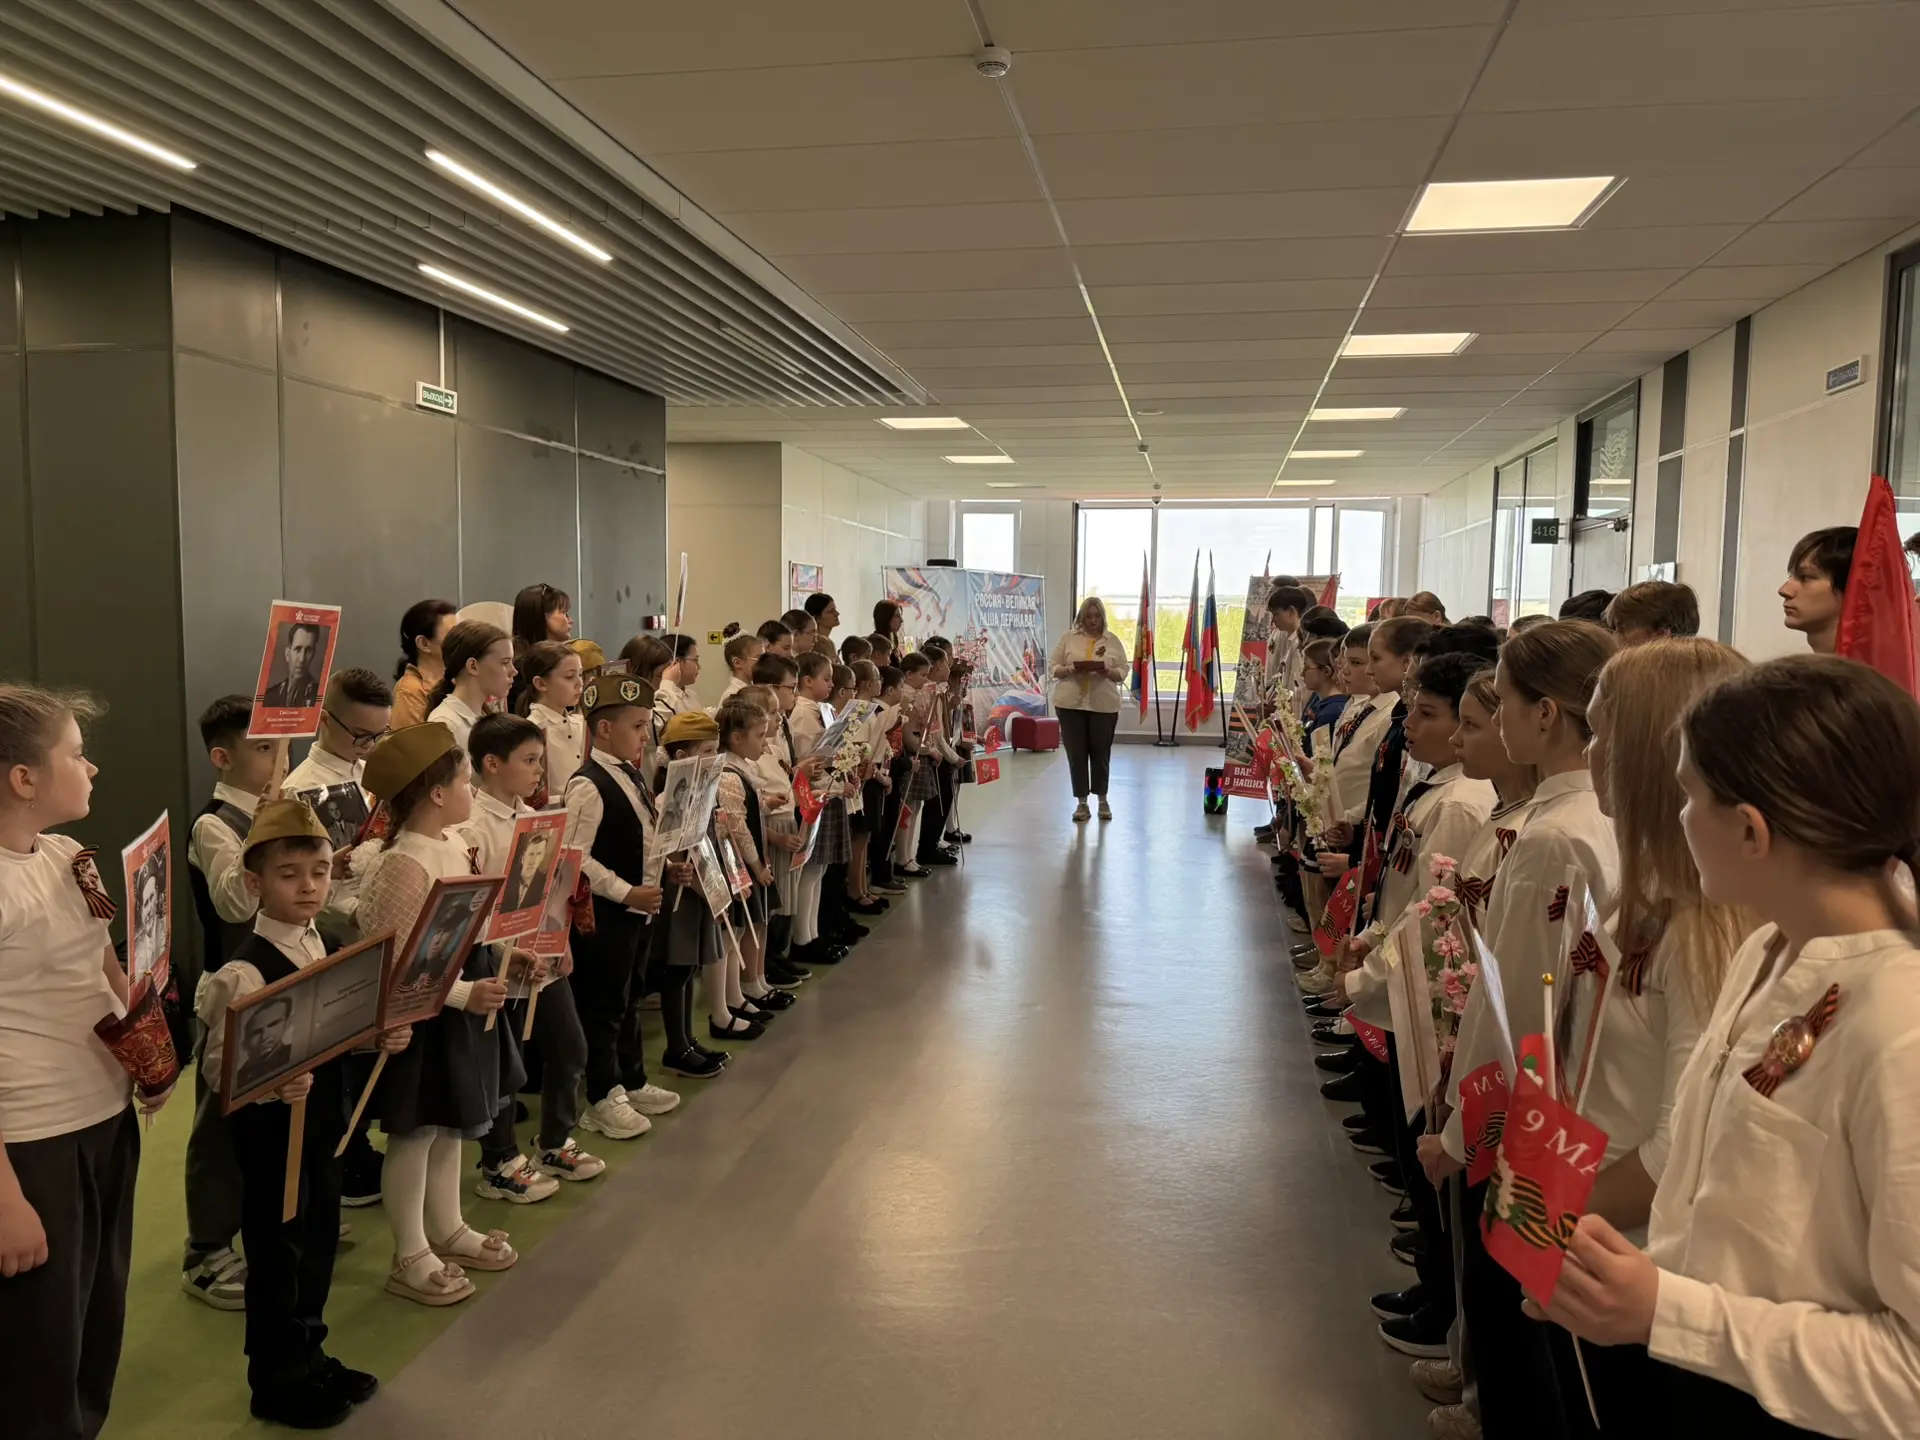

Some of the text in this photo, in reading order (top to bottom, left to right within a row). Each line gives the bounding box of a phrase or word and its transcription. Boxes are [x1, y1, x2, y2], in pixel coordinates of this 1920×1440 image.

[423, 390, 443, 404] ВЫХОД
[1533, 526, 1557, 537] 416
[1006, 594, 1036, 609] ВЕЛИКАЯ
[980, 612, 1036, 628] НАША ДЕРЖАВА!
[1225, 777, 1265, 789] В НАШИХ
[1520, 1109, 1545, 1132] 9
